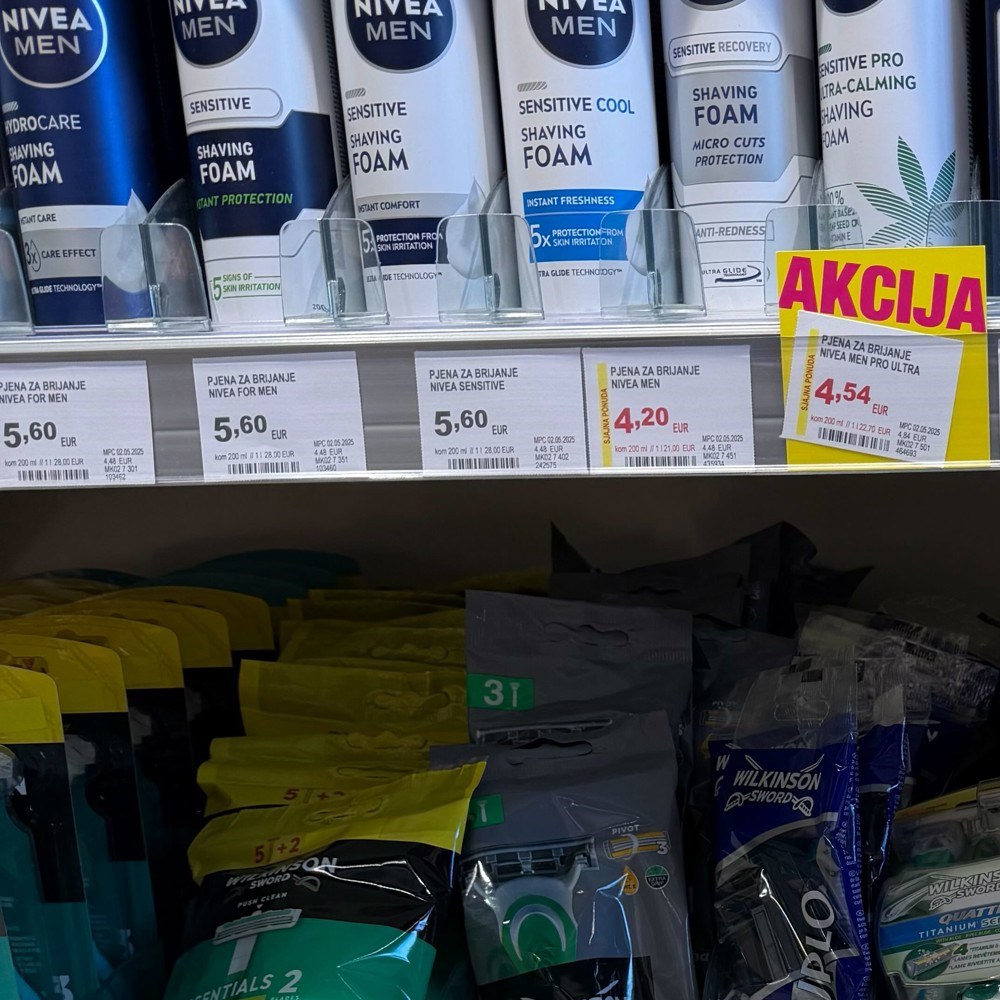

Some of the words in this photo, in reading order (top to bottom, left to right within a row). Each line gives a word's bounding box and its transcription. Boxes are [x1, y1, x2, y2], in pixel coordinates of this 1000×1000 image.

[1, 6, 92, 33] NIVEA
[551, 16, 616, 38] MEN
[14, 36, 81, 56] MEN
[673, 43, 716, 59] SENSITIVE
[718, 41, 772, 53] RECOVERY
[692, 86, 758, 101] SHAVING
[190, 97, 251, 114] SENSITIVE
[347, 101, 407, 122] SENSITIVE
[519, 97, 593, 115] SENSITIVE
[596, 98, 635, 114] COOL
[694, 104, 759, 126] FOAM
[5, 115, 81, 136] HYDROCARE
[9, 142, 54, 162] SHAVING
[693, 138, 729, 151] MICRO
[734, 137, 766, 148] CUTS
[695, 154, 763, 167] PROTECTION
[12, 161, 63, 188] FOAM
[221, 193, 293, 206] PROTECTION
[527, 196, 559, 207] INSTANT
[561, 196, 615, 205] FRESHNESS
[695, 224, 766, 238] ANTI-REDNESS
[41, 250, 61, 259] CARE
[63, 249, 96, 257] EFFECT
[239, 283, 280, 291] IRRITATION
[779, 256, 987, 333] AKCIJA
[821, 335, 851, 349] PJENA
[852, 340, 866, 351] ZA
[867, 343, 912, 361] BRIJANJE
[820, 348, 847, 361] NIVEA
[849, 353, 868, 365] MEN
[870, 358, 889, 369] PRO
[890, 362, 920, 376] ULTRA
[612, 379, 639, 389] NIVEA
[641, 379, 660, 388] MEN
[814, 378, 871, 405] 4,54
[872, 404, 888, 416] EUR
[214, 414, 268, 443] 5,60
[434, 409, 488, 437] 5,60
[614, 407, 669, 433] 4,20
[733, 770, 822, 791] WILKINSON
[749, 789, 793, 804] SWORD
[612, 825, 640, 835] PIVOT
[918, 922, 977, 938] TITANIUM
[278, 969, 303, 993] 2
